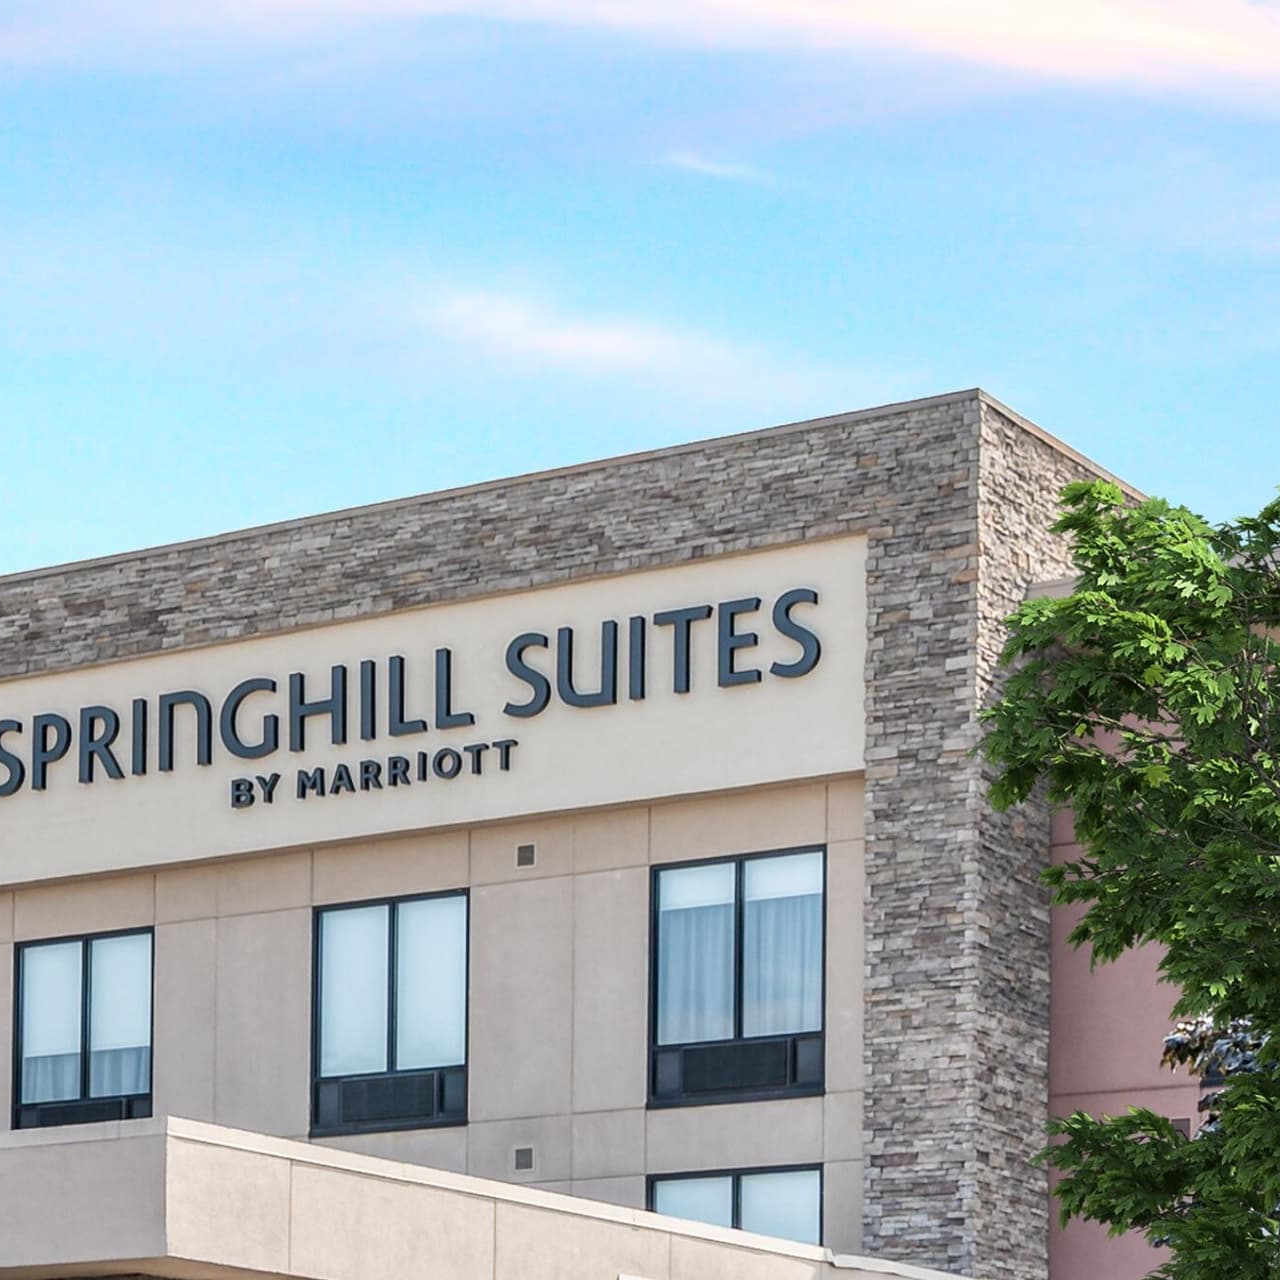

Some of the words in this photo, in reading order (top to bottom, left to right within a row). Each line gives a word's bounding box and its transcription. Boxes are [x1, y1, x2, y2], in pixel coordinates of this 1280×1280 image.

[503, 588, 823, 719] SUITES
[230, 772, 281, 810] BY
[296, 738, 520, 802] MARRIOTT
